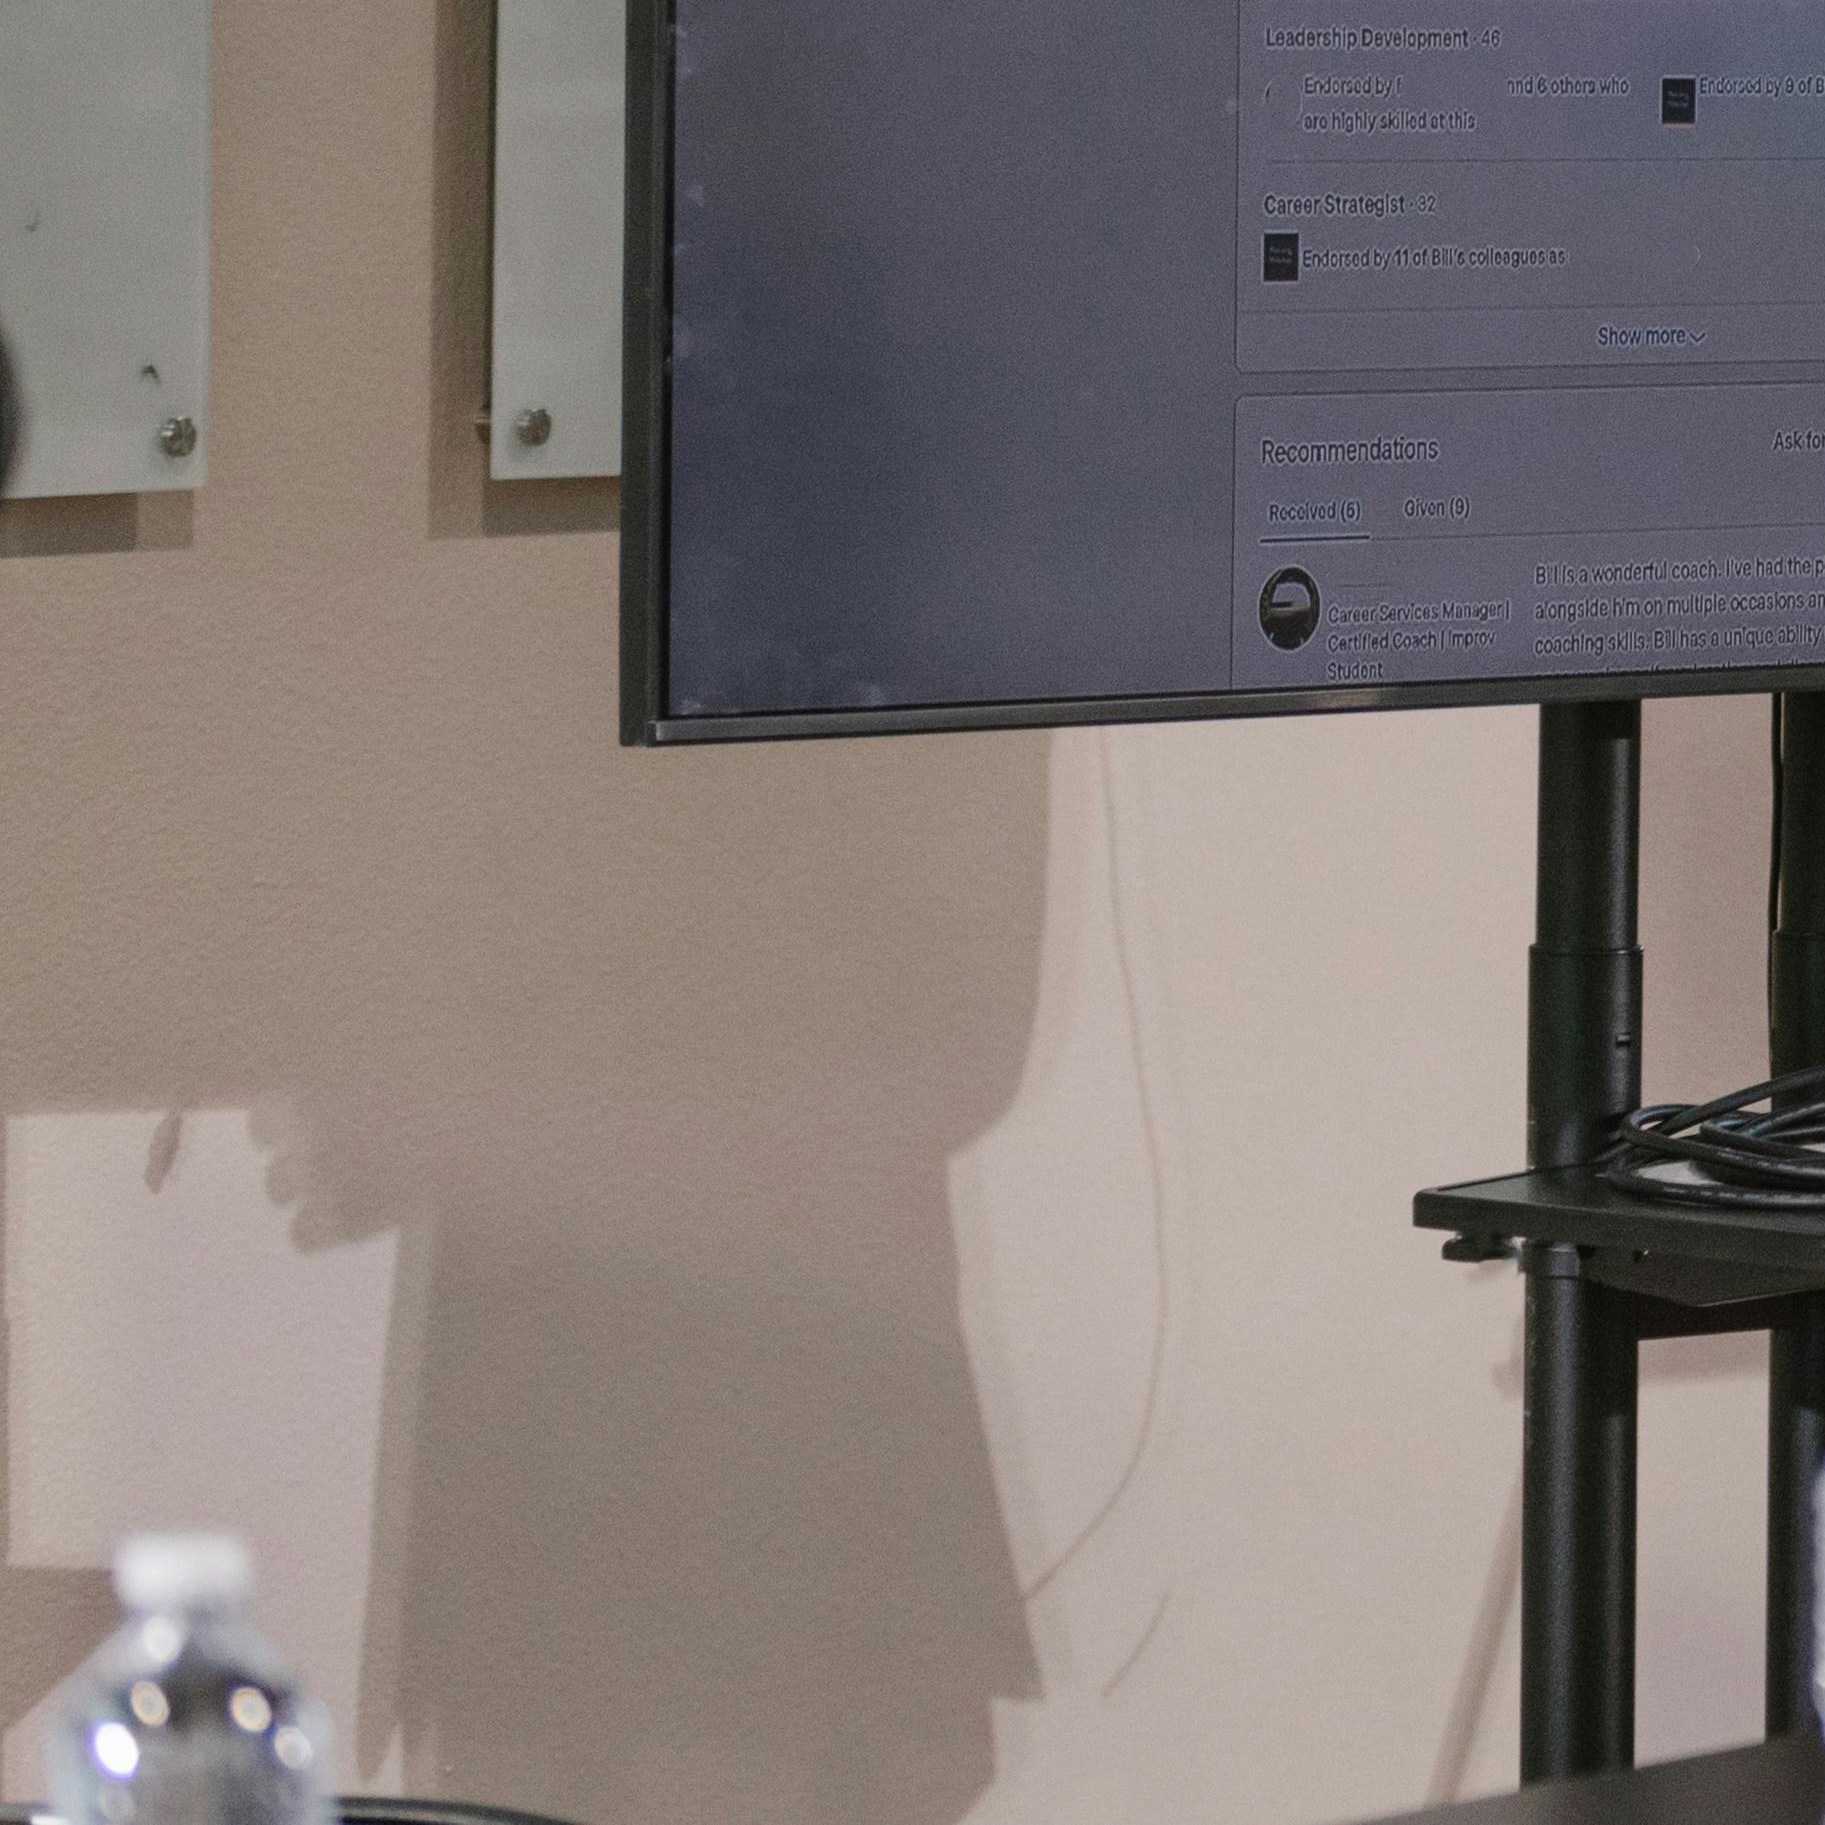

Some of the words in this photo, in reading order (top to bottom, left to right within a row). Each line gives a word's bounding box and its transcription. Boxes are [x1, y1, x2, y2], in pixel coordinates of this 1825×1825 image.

[1266, 30, 1356, 51] Leadership
[1361, 28, 1467, 51] Development
[1264, 195, 1319, 214] Career
[1325, 193, 1404, 216] Strategist
[1598, 327, 1640, 344] Show
[1646, 329, 1684, 343] more
[1262, 439, 1436, 462] Recommendations
[1774, 431, 1801, 449] Ask
[1269, 501, 1336, 520] Received
[1405, 498, 1444, 516] Given
[1536, 565, 1557, 584] Bill
[1562, 565, 1574, 583] is
[1580, 568, 1587, 582] a
[1592, 563, 1666, 582] wonderful
[1726, 561, 1750, 577] I've
[1756, 557, 1783, 576] had
[1788, 557, 1810, 575] the
[1329, 606, 1374, 623] Career
[1380, 601, 1438, 622] Services
[1442, 603, 1501, 624] Manager
[1328, 660, 1382, 679] Student
